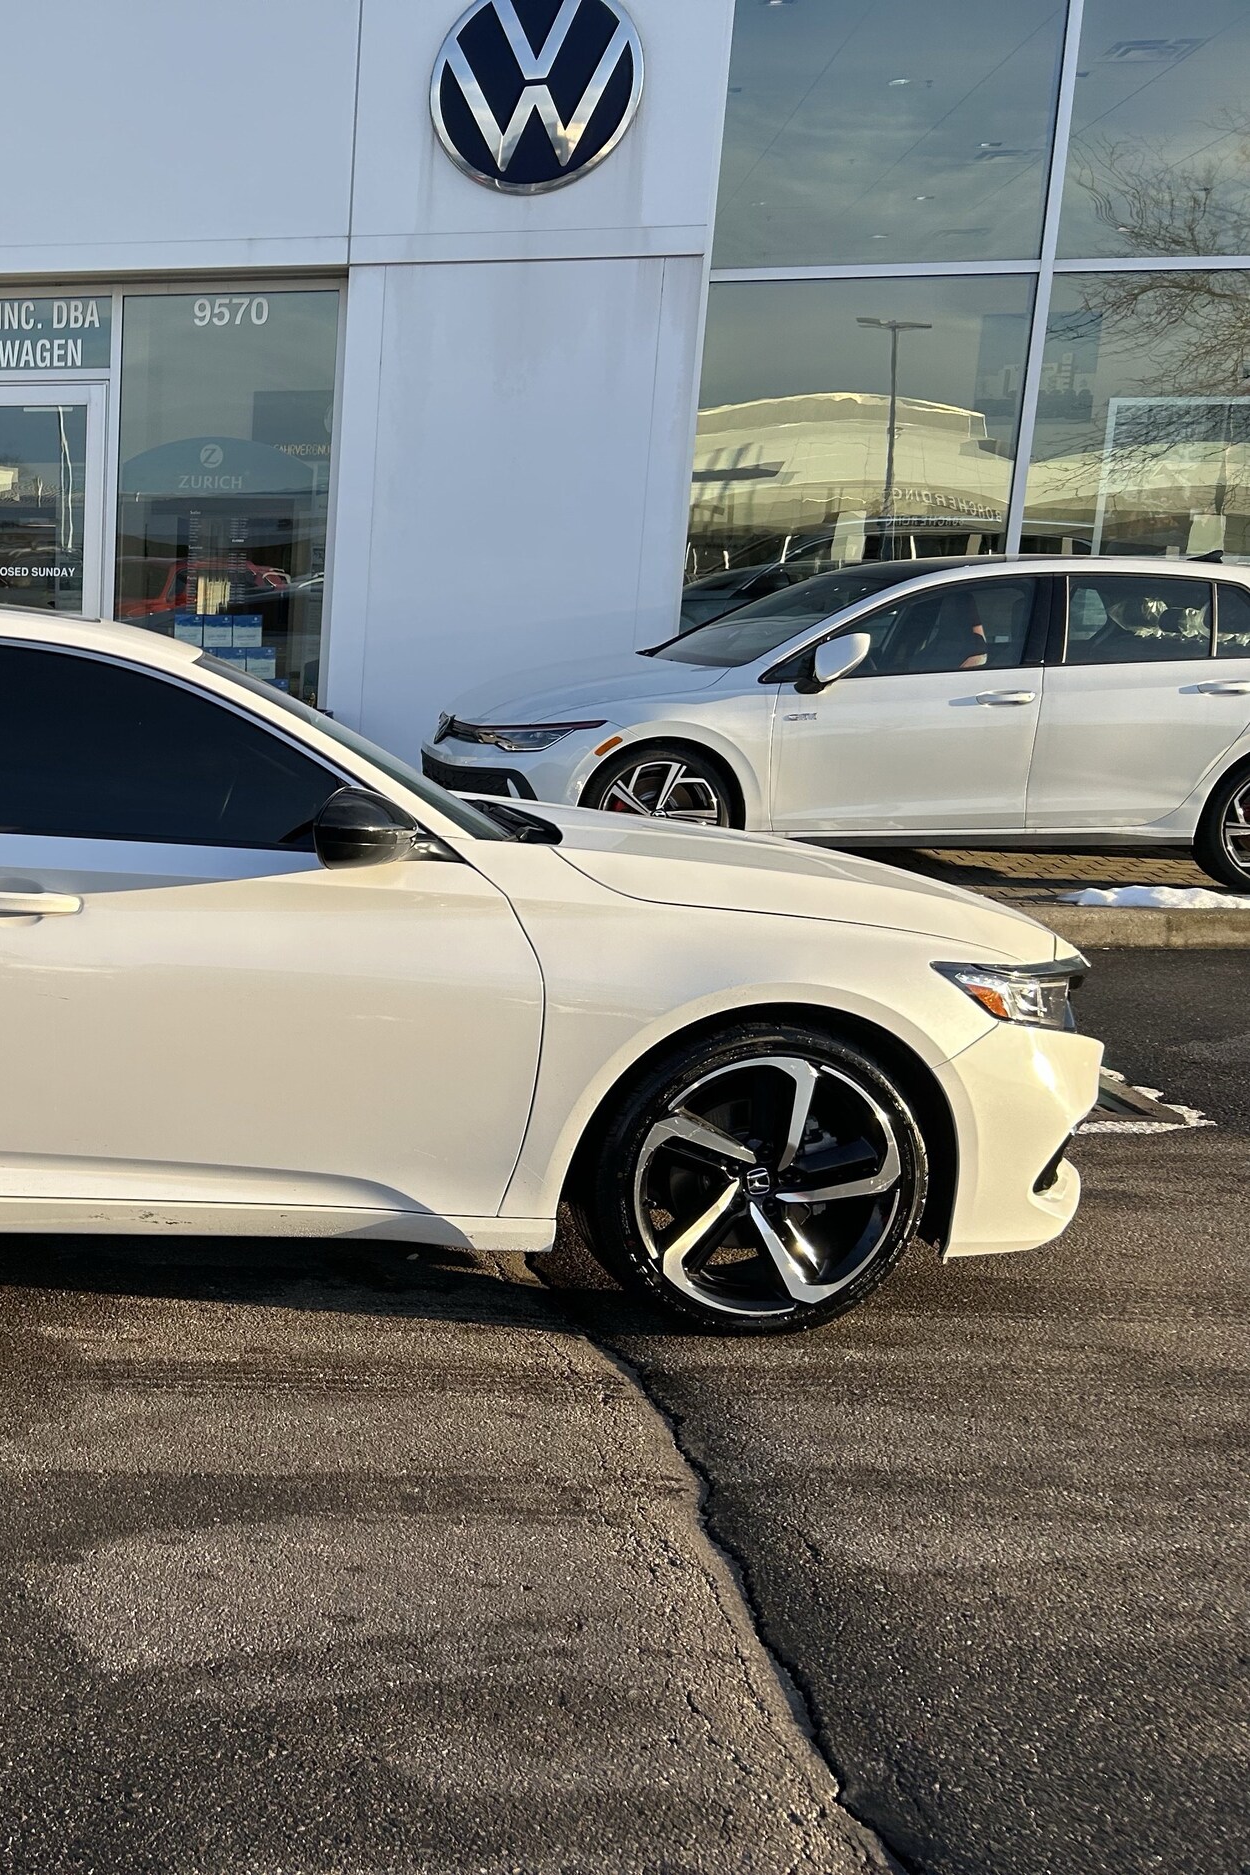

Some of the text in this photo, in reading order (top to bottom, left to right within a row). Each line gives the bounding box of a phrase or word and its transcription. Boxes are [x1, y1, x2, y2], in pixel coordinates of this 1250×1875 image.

[52, 299, 101, 330] DBA
[193, 297, 269, 327] 9570
[178, 475, 243, 490] ZURICH
[31, 567, 76, 577] SUNDAY
